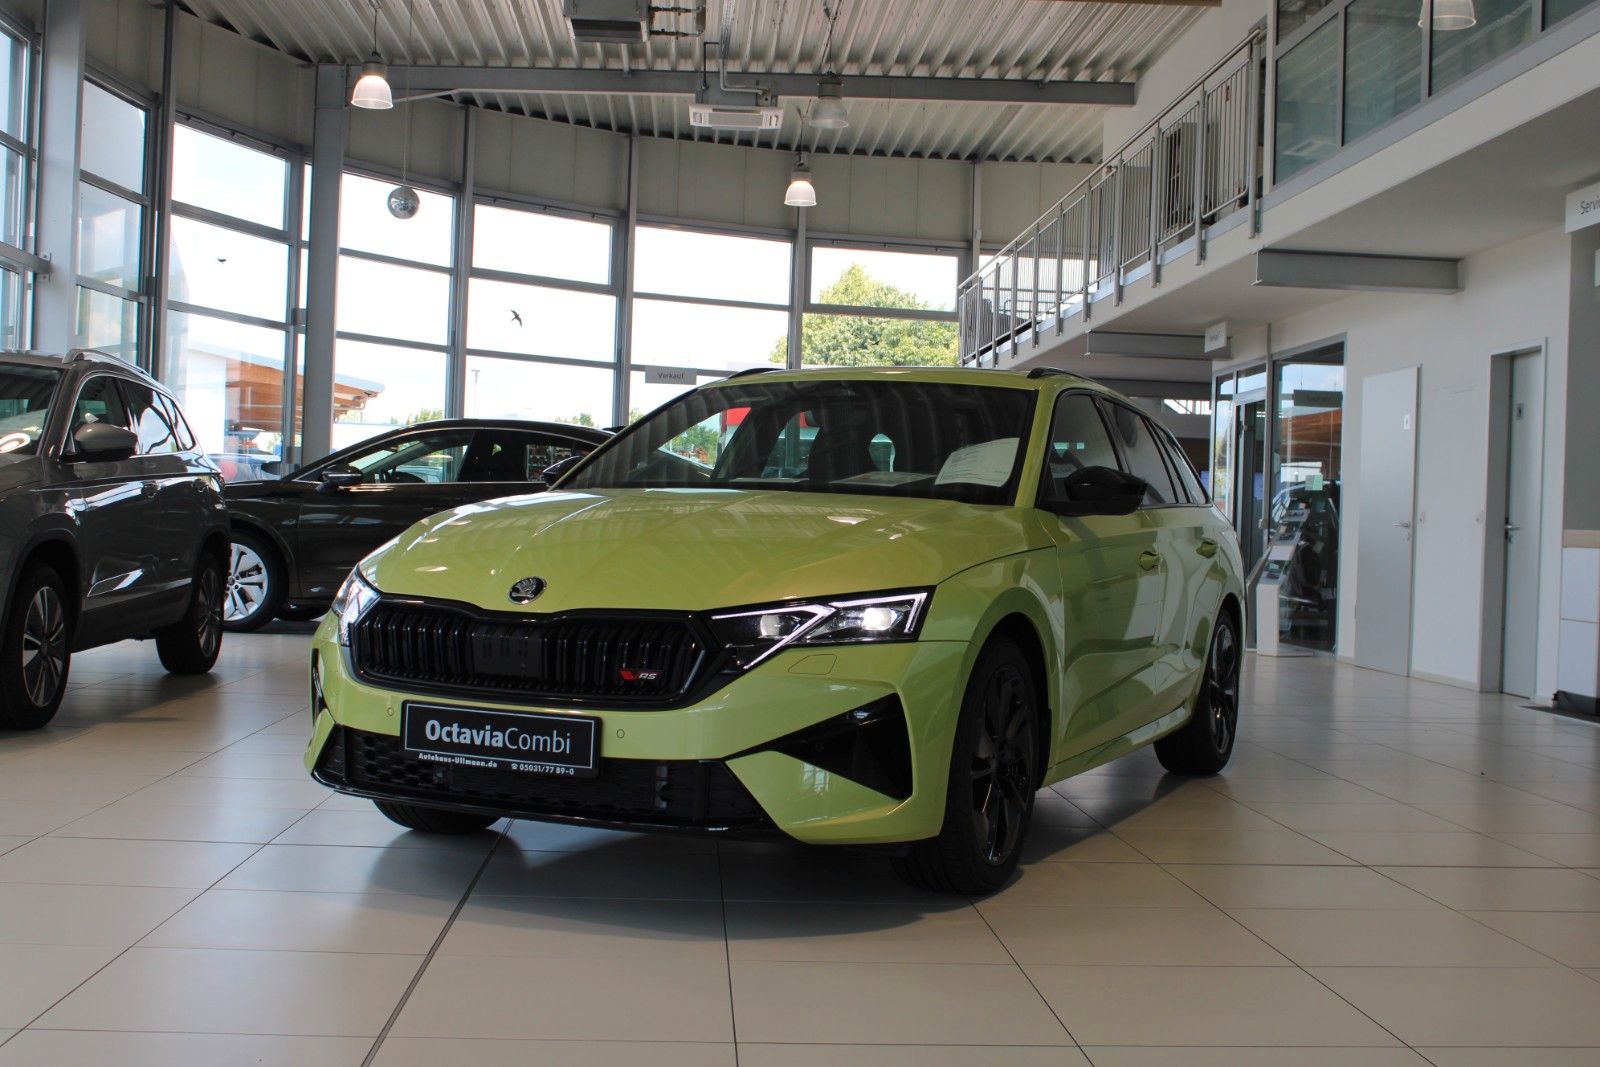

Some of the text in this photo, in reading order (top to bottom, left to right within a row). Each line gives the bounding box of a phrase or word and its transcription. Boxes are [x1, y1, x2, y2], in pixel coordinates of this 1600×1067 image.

[1580, 195, 1600, 215] Servi
[657, 371, 685, 380] Verkauf
[418, 752, 498, 769] Autohaus-Ullmann.de
